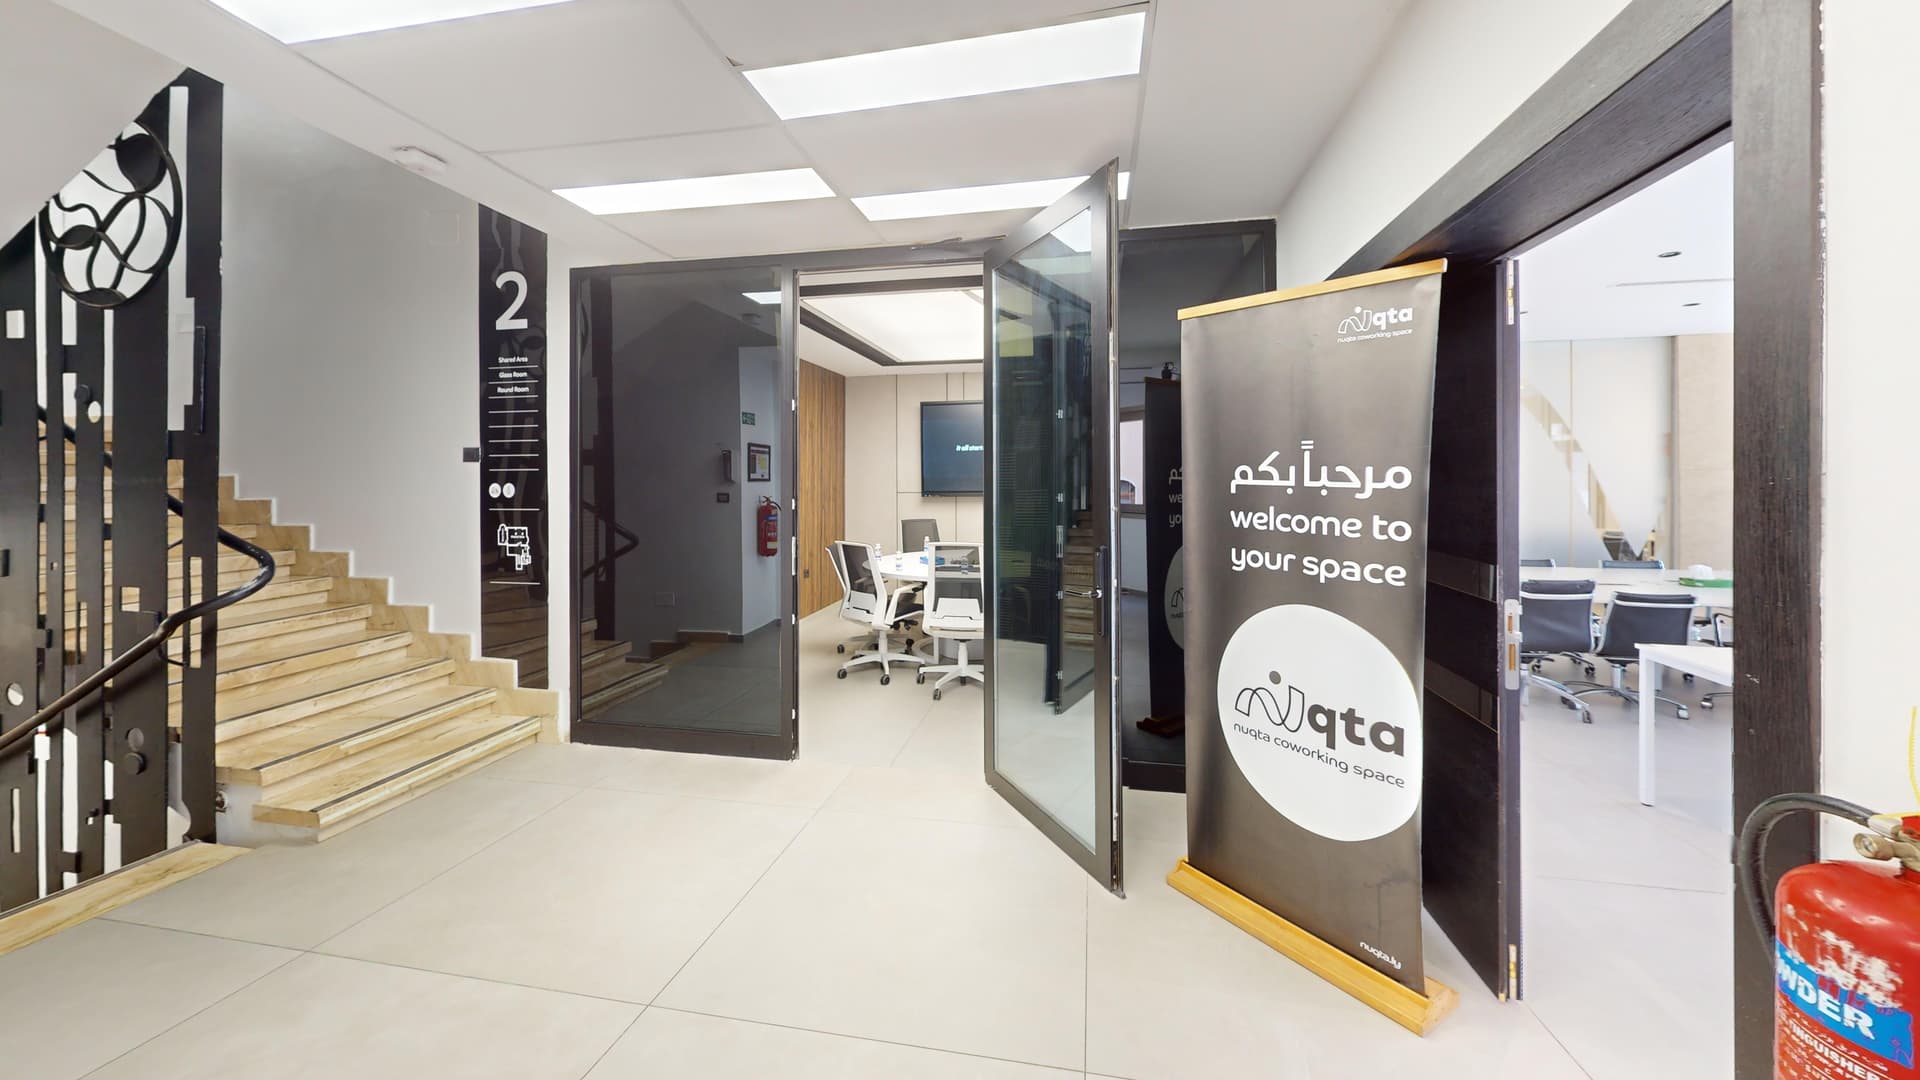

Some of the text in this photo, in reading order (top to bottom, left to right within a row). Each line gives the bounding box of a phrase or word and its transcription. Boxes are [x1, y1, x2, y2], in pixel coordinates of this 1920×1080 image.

[495, 271, 528, 331] 2
[1230, 451, 1296, 495] بكم
[1229, 506, 1412, 542] welcome to
[1230, 547, 1407, 587] your space
[1233, 722, 1405, 788] nuqta coworking space
